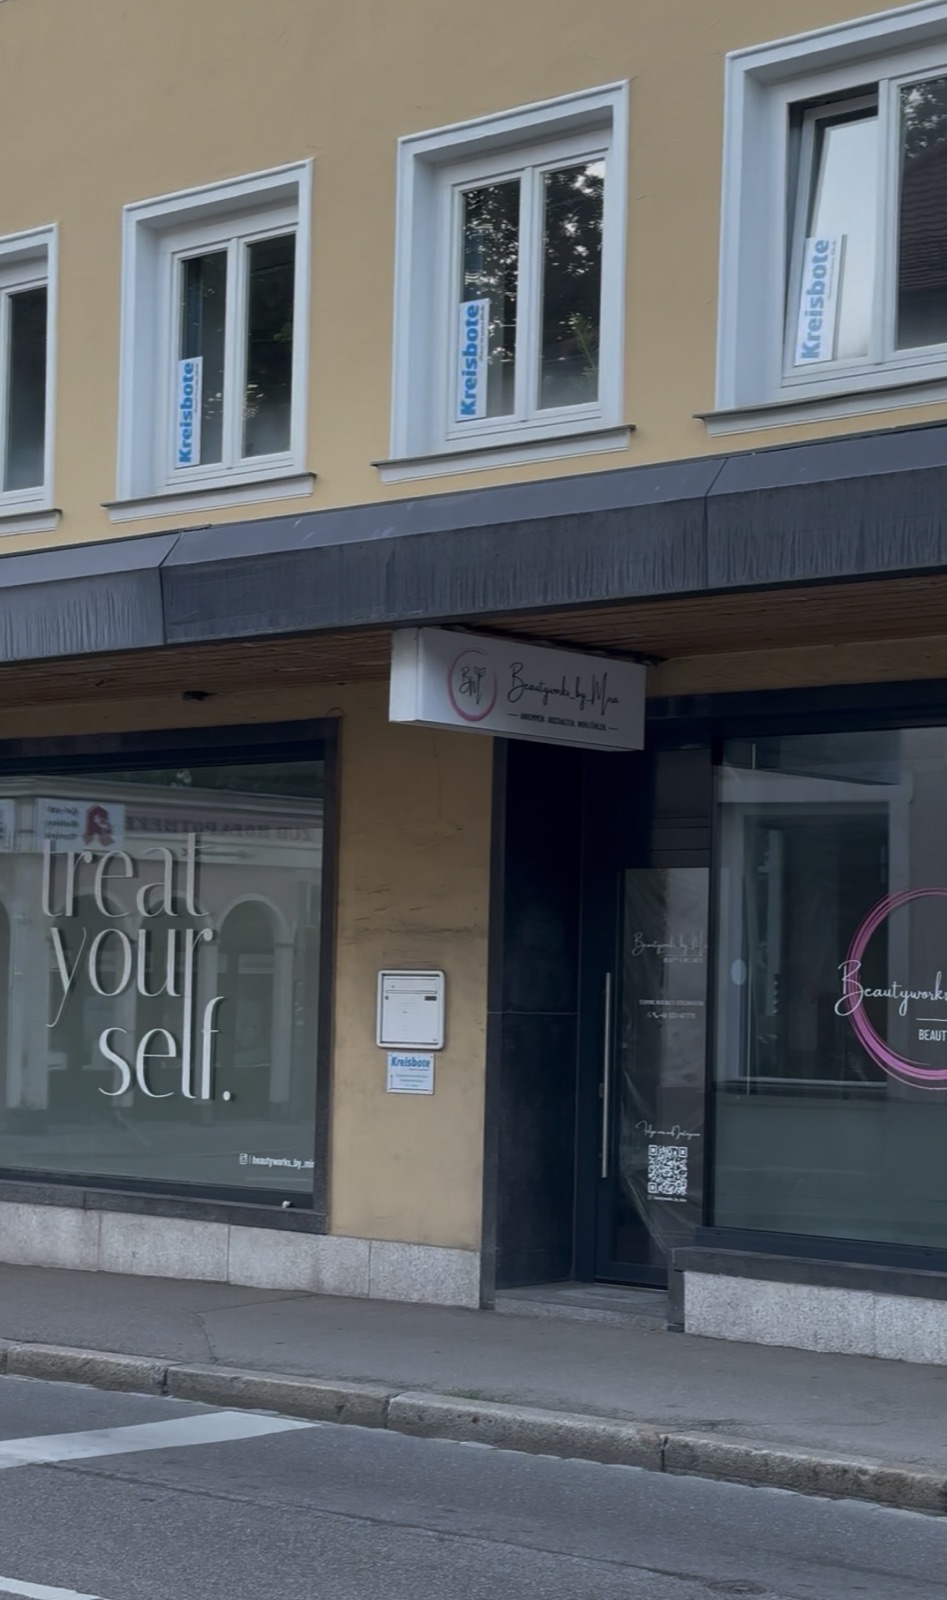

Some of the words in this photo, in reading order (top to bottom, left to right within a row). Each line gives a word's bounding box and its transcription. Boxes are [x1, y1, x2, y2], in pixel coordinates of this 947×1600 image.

[800, 239, 829, 359] Kreisbote
[460, 304, 479, 416] Kreisbote
[179, 362, 194, 463] Kreisbote
[42, 832, 214, 917] treat
[46, 927, 213, 1027] your
[834, 959, 947, 1016] Beautyworks
[98, 996, 231, 1101] self.
[391, 1056, 431, 1068] Kreisbote
